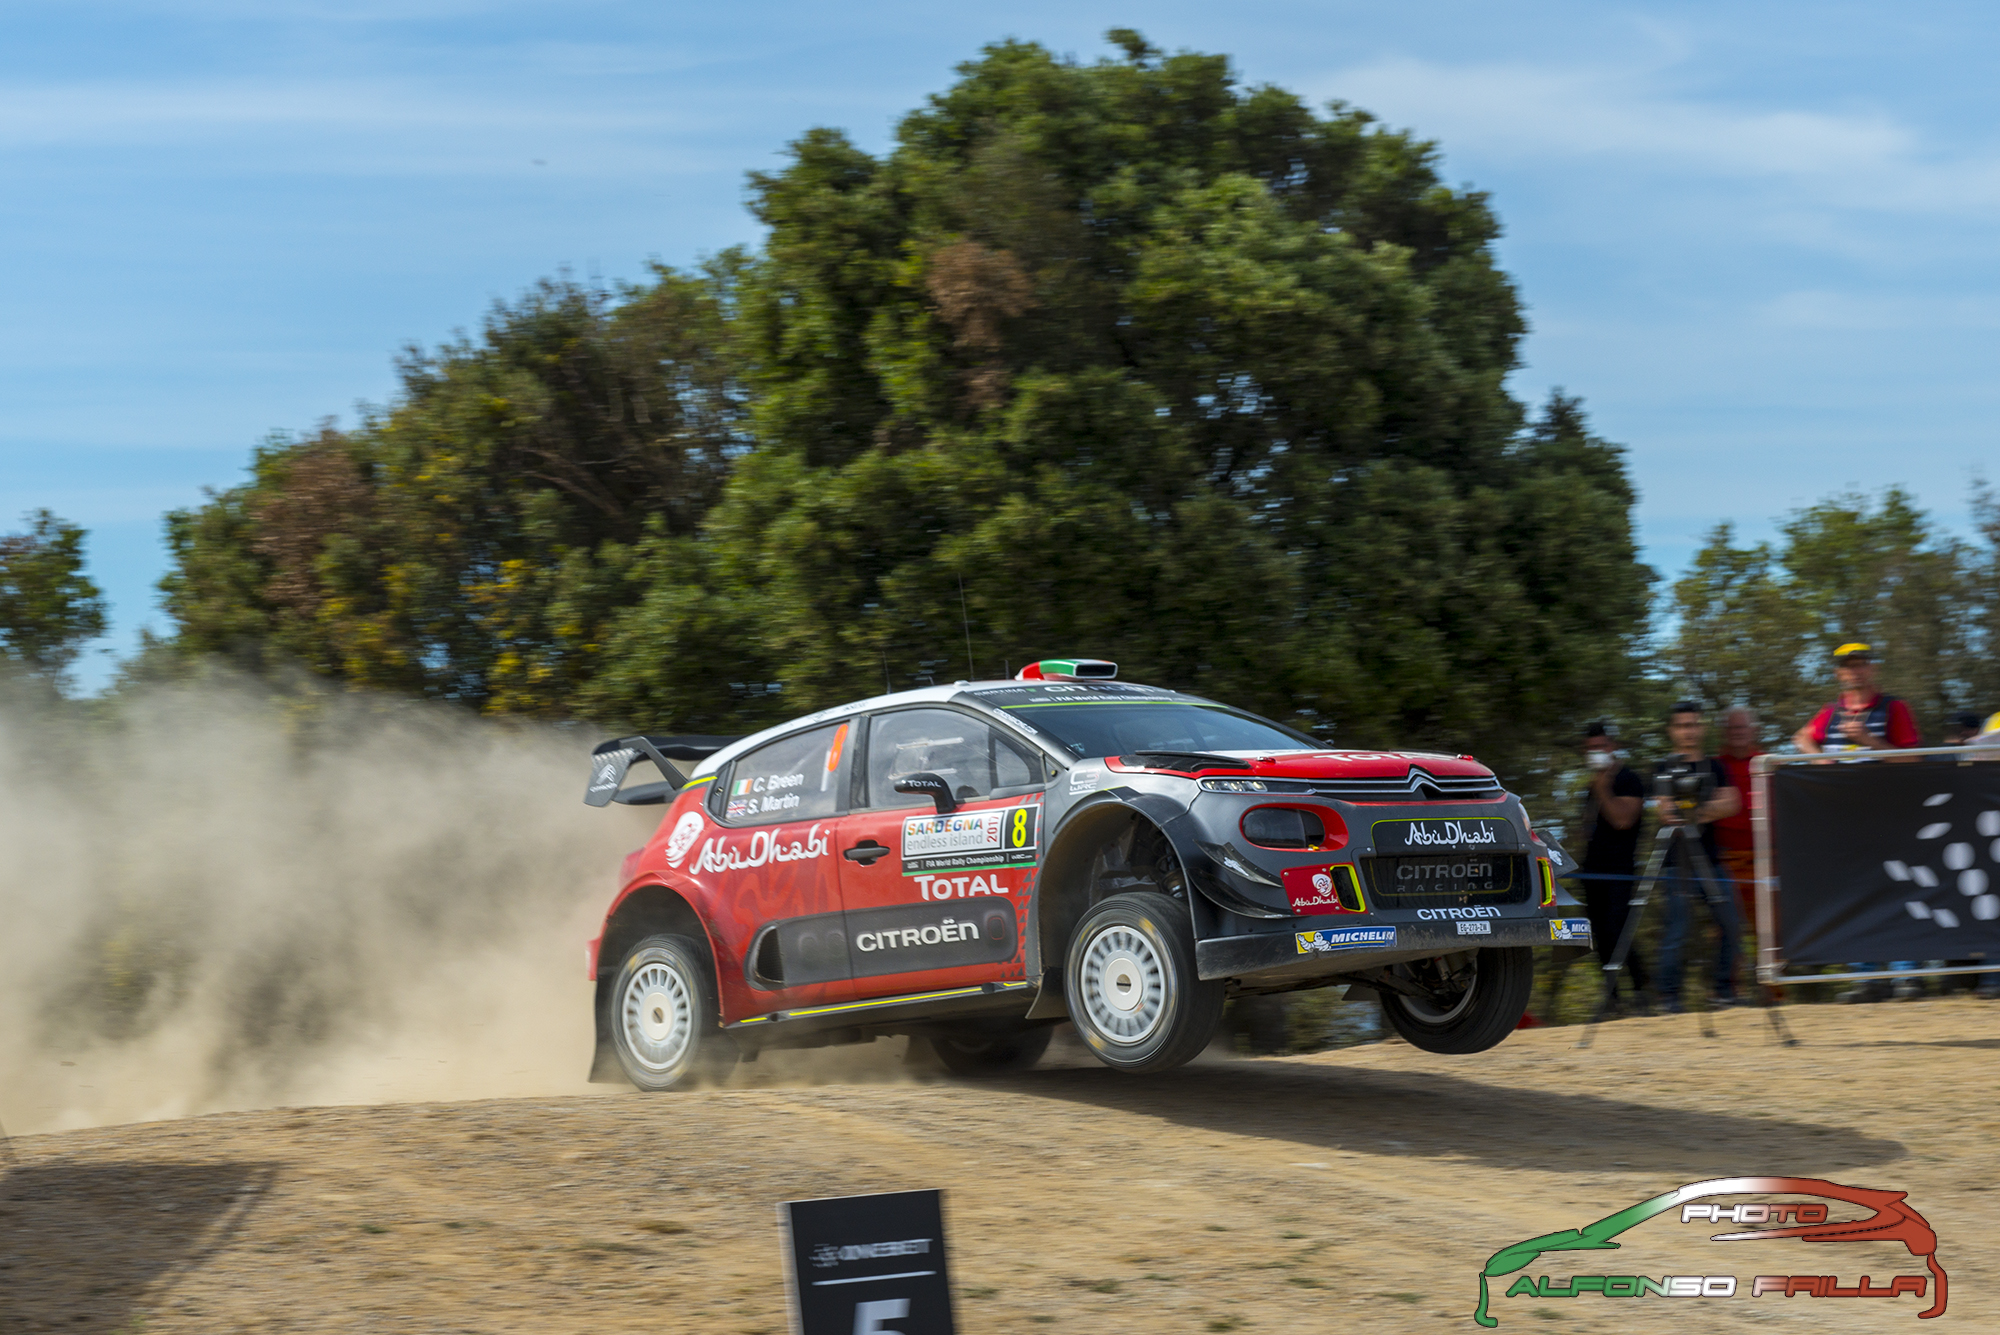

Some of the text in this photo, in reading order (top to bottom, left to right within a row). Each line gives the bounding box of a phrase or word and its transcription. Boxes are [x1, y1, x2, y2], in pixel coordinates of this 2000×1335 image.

[827, 723, 849, 772] 8
[753, 774, 804, 793] C. Breen
[747, 793, 800, 815] S. Martin
[907, 818, 983, 836] SARDEGNA
[987, 815, 999, 843] 2017
[1012, 808, 1028, 848] 8
[907, 831, 983, 851] endless island
[914, 873, 1009, 901] TOTAL
[1331, 931, 1395, 943] MICHELIN
